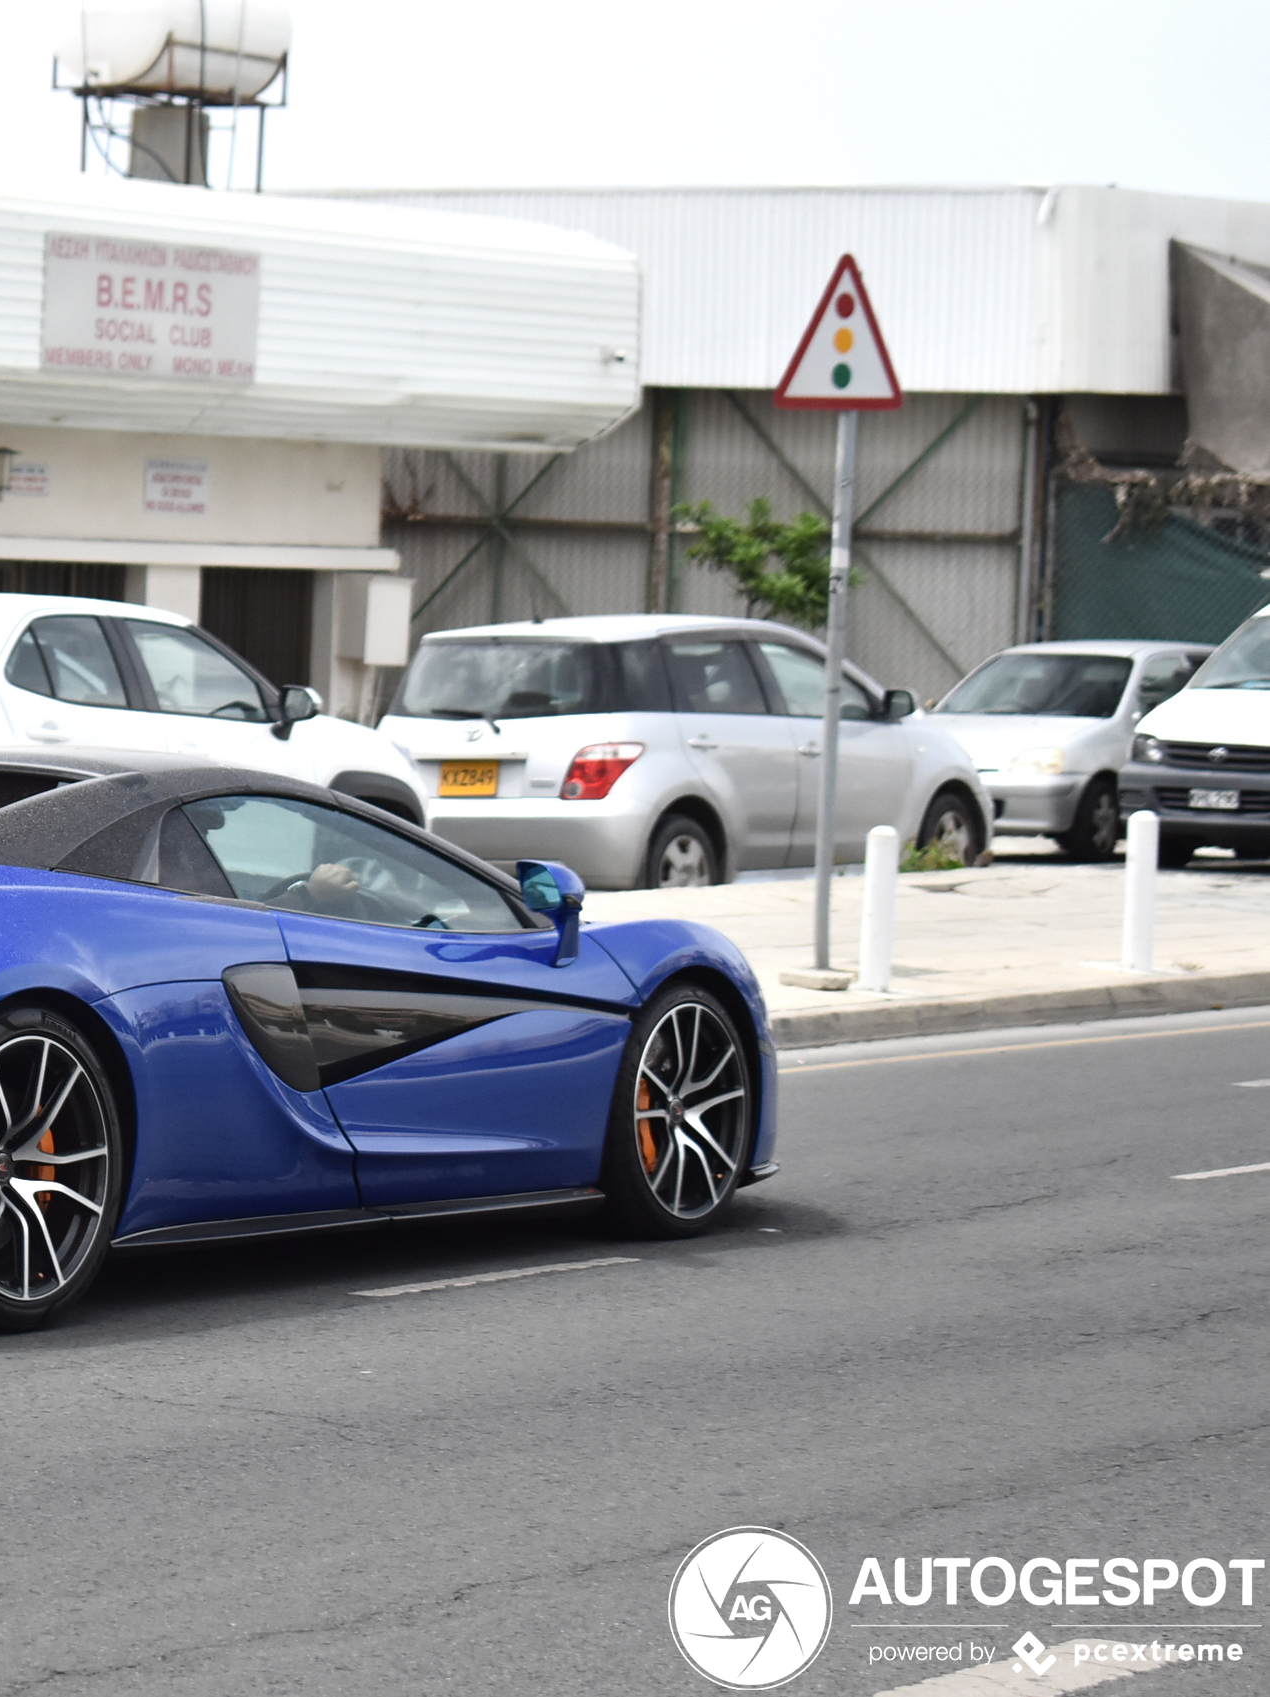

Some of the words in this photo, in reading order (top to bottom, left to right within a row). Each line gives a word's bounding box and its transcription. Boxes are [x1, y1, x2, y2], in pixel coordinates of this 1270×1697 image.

[96, 273, 212, 317] B.E.M.R.S
[94, 318, 155, 344] SOCIAL
[169, 324, 212, 348] CLUB
[44, 347, 112, 369] MEMBERS
[118, 351, 152, 371] ONLY
